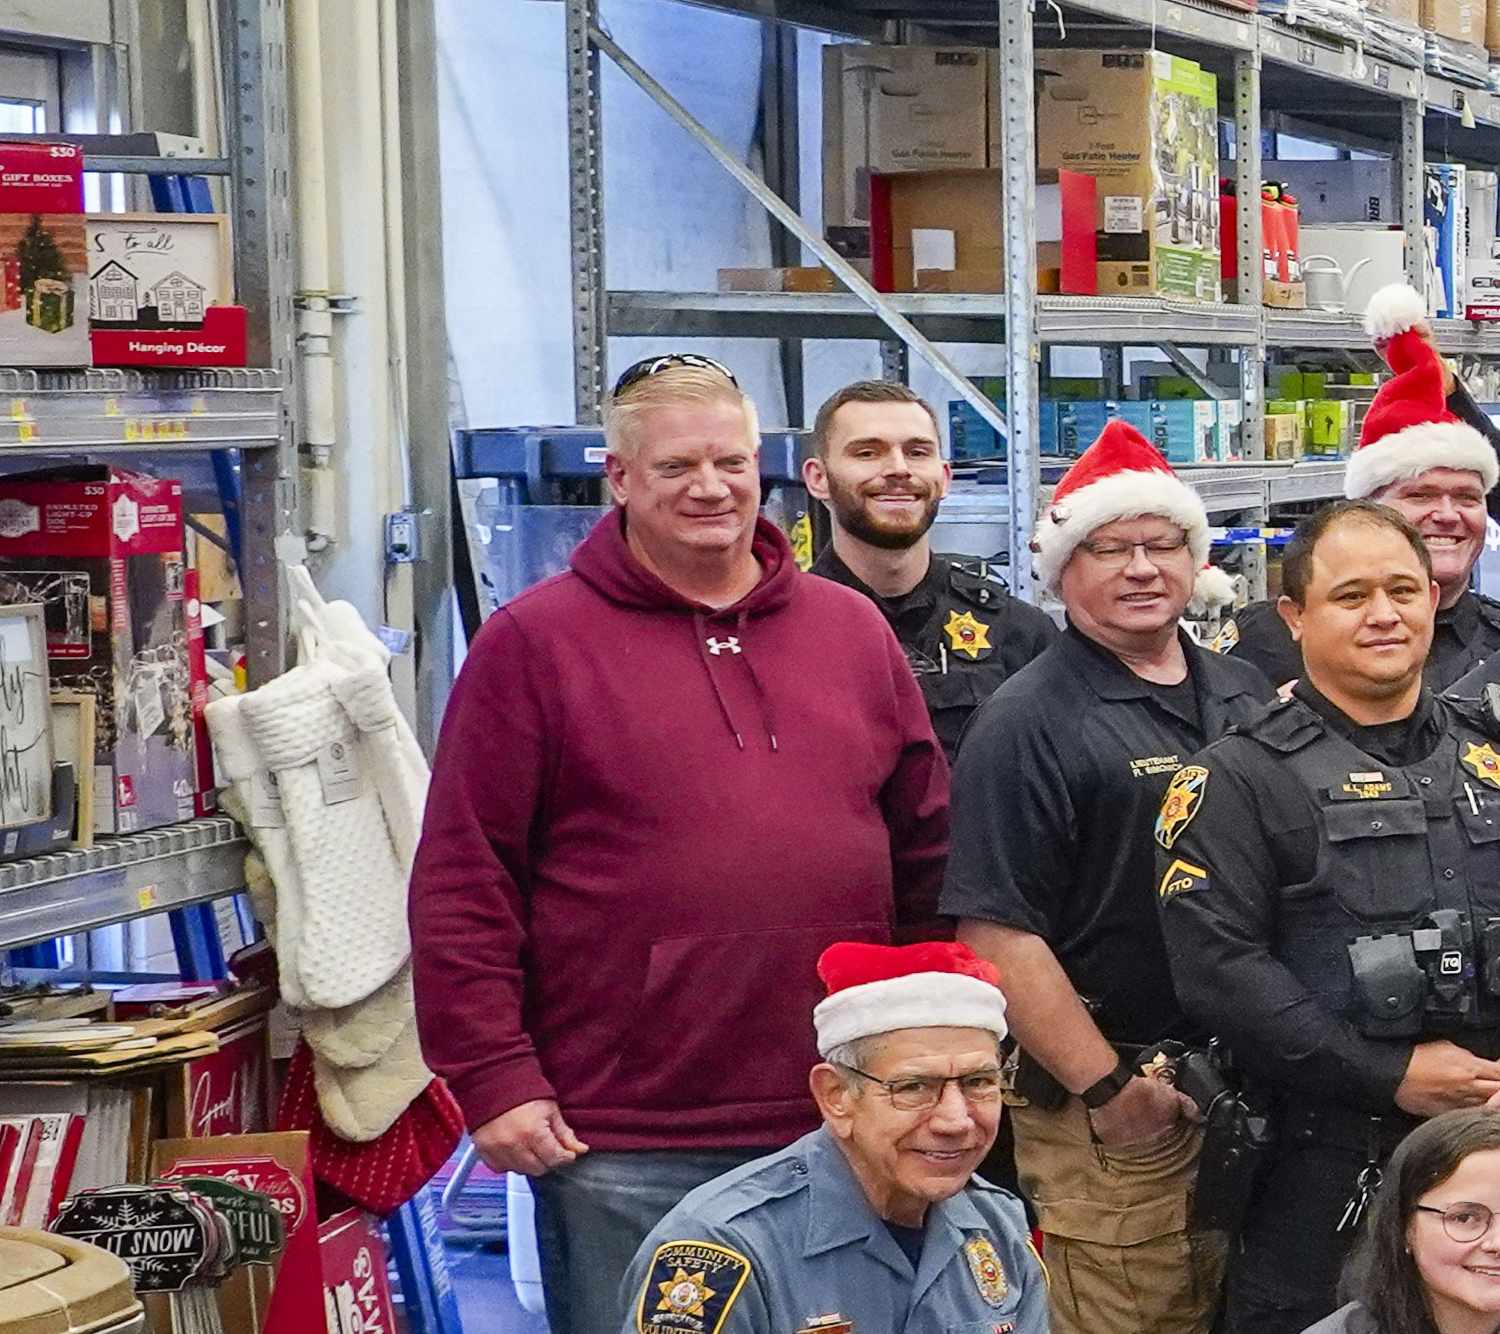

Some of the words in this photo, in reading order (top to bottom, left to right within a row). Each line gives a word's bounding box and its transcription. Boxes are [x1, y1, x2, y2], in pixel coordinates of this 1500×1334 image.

[50, 146, 77, 159] $30
[1, 173, 31, 183] GIFT
[32, 173, 74, 183] BOXES
[128, 341, 184, 356] Hanging
[186, 340, 227, 354] Décor
[130, 1227, 196, 1256] SNOW
[655, 1244, 744, 1273] COMMUNITY
[665, 1256, 721, 1275] SAFETY
